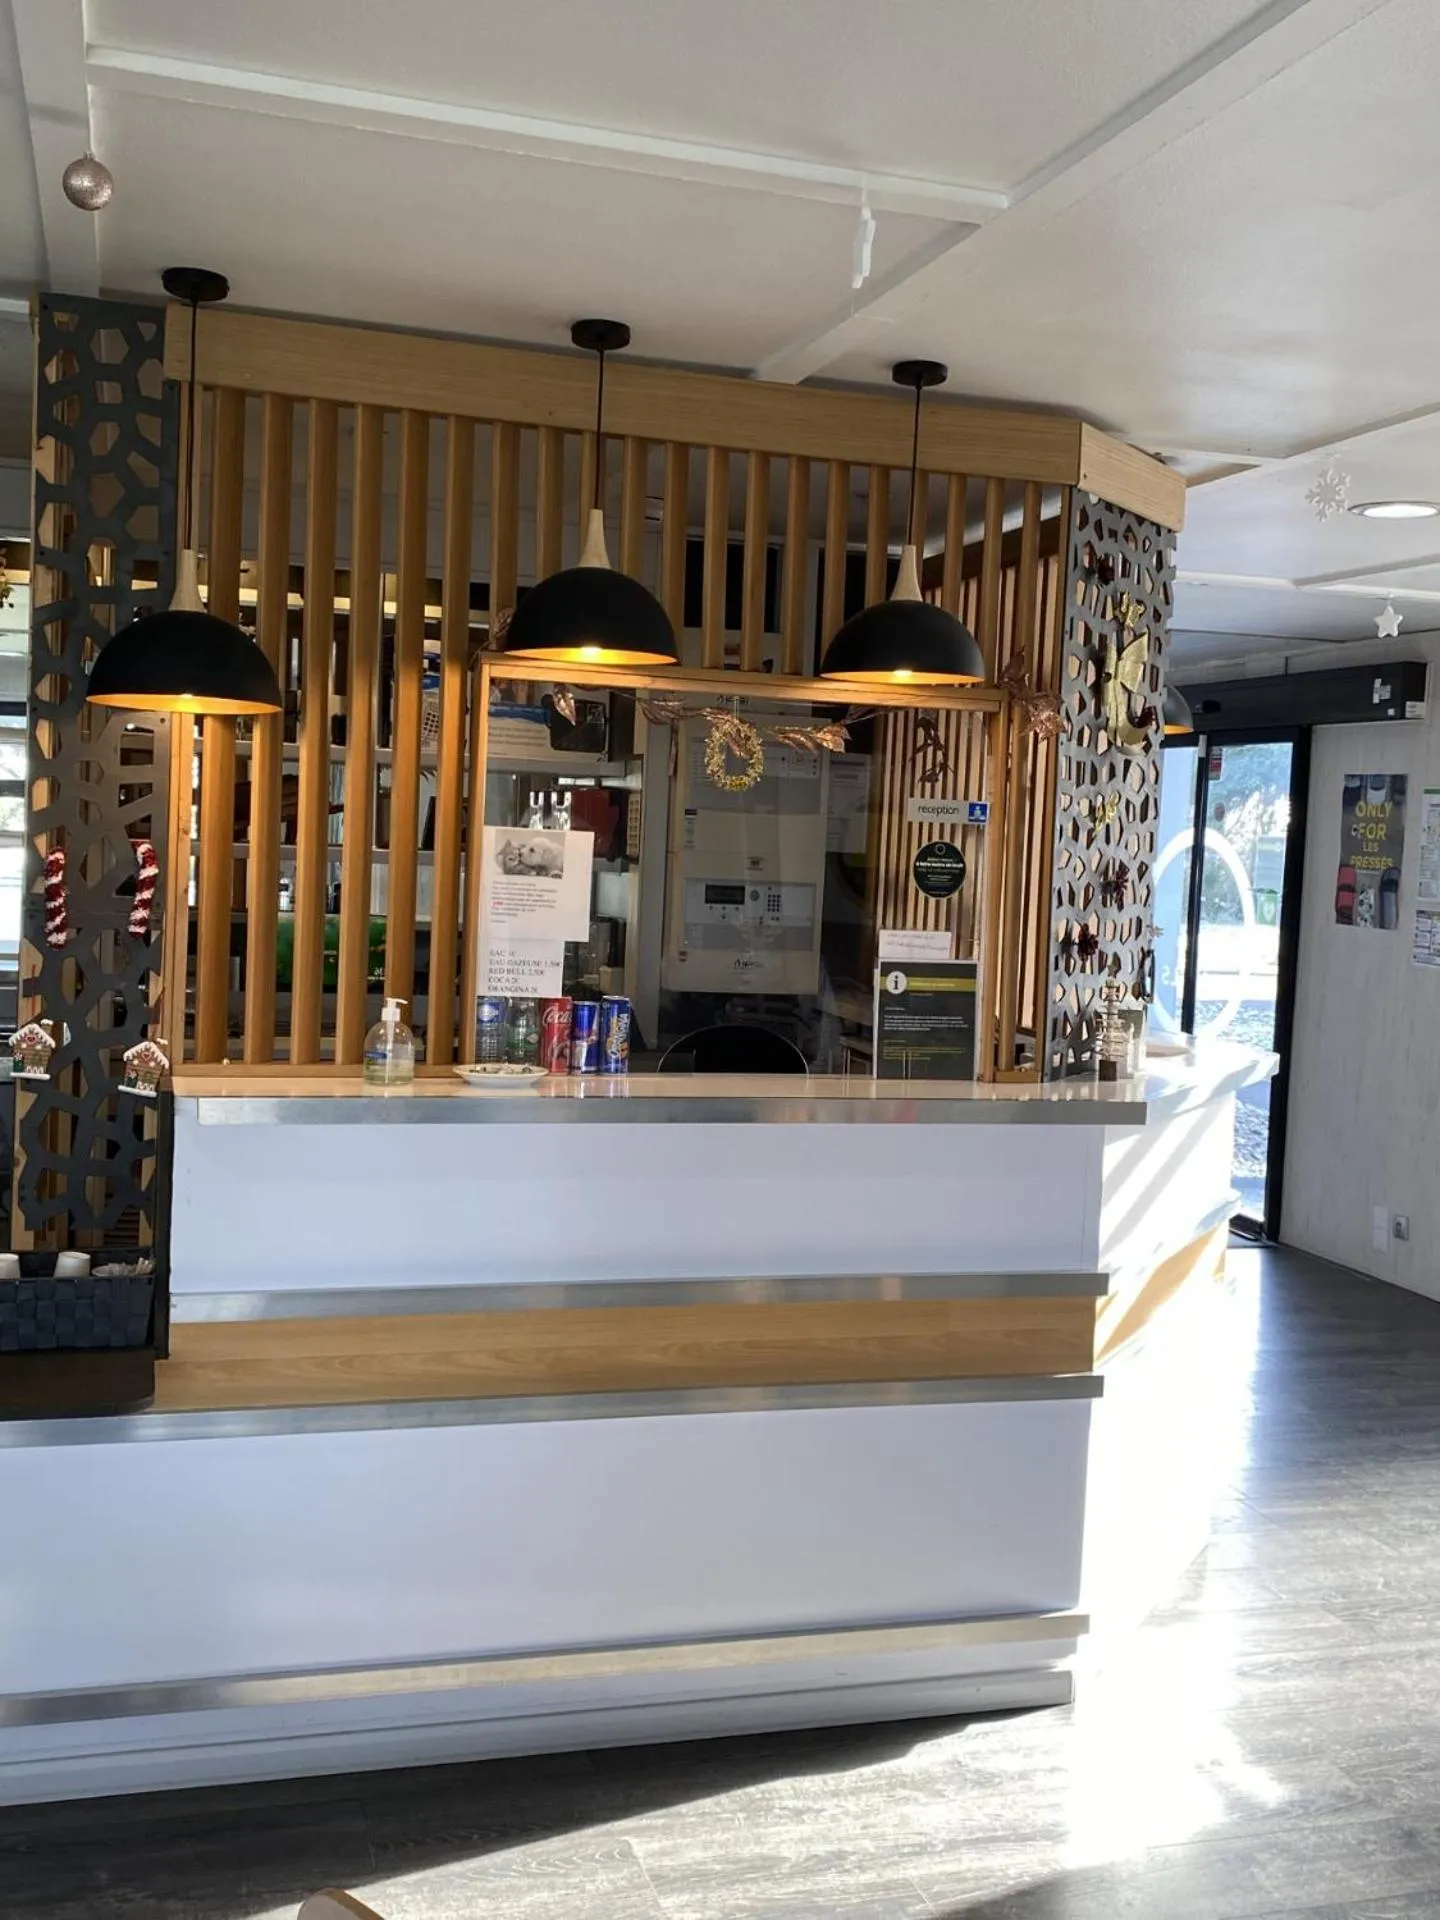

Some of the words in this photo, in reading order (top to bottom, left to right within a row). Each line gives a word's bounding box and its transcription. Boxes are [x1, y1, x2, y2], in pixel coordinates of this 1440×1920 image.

[918, 805, 959, 816] reception
[1356, 801, 1393, 818] ONLY
[1359, 823, 1387, 840] FOR
[506, 968, 525, 976] BULL
